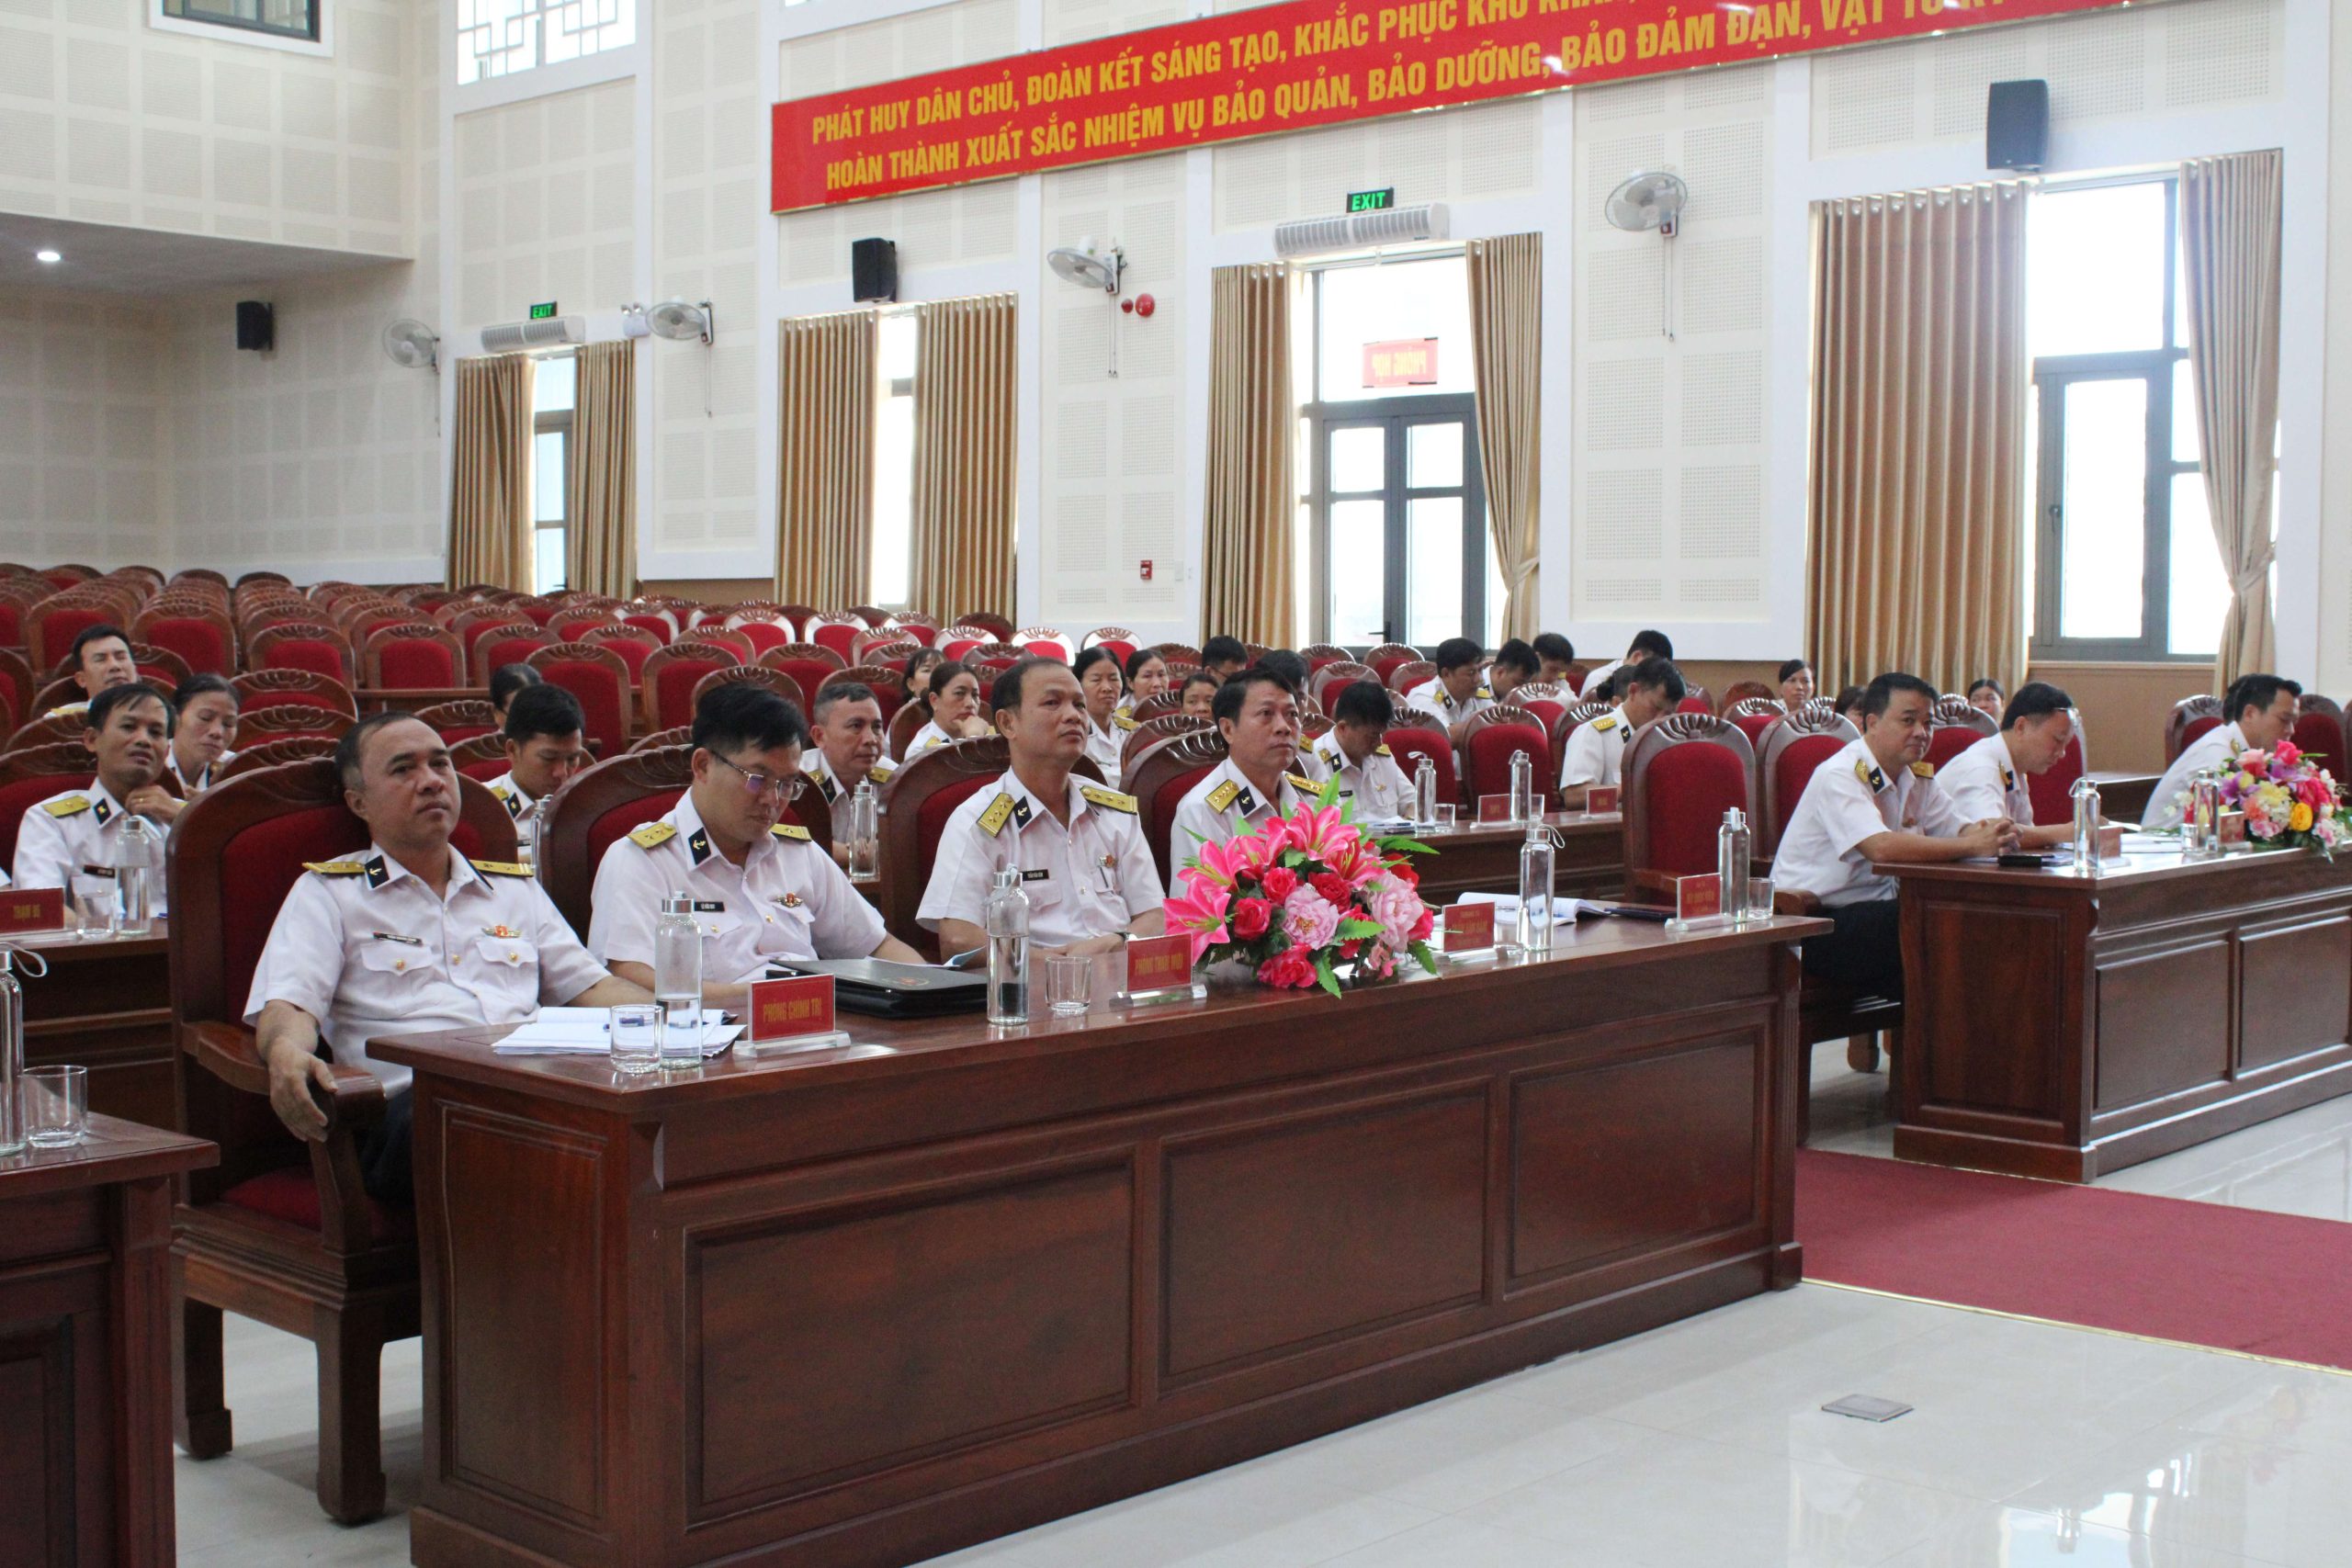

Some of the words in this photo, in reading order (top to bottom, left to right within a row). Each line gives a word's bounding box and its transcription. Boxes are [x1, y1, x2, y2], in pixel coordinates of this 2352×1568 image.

[812, 104, 864, 144] PHÁT
[870, 100, 910, 134] HUY
[917, 87, 961, 125] DÂN
[967, 70, 1020, 116] CHỦ,
[1026, 62, 1091, 106] ĐOÀN
[1099, 47, 1144, 93] KẾT
[1150, 40, 1221, 84] SÁNG
[1229, 30, 1286, 73] TẠO,
[1295, 2, 1369, 57] KHẮC
[1378, 0, 1457, 43] PHỤC
[827, 152, 882, 190] HOÀN
[889, 141, 959, 179] THÀNH
[966, 121, 1023, 167] XUẤT
[1031, 112, 1077, 156] SẮC
[1084, 103, 1164, 148] NHIỆM
[1172, 98, 1204, 138] VỤ
[1212, 80, 1265, 127] BẢO
[1274, 66, 1358, 118] QUẢN,
[1368, 52, 1426, 102] BẢO
[1436, 39, 1550, 92] DƯỠNG,
[1562, 19, 1625, 71] BẢO
[1636, 6, 1715, 60] ĐẢM
[1726, 2, 1812, 50] ĐẠN,
[1351, 192, 1386, 211] EXIT
[533, 305, 552, 319] EXIT
